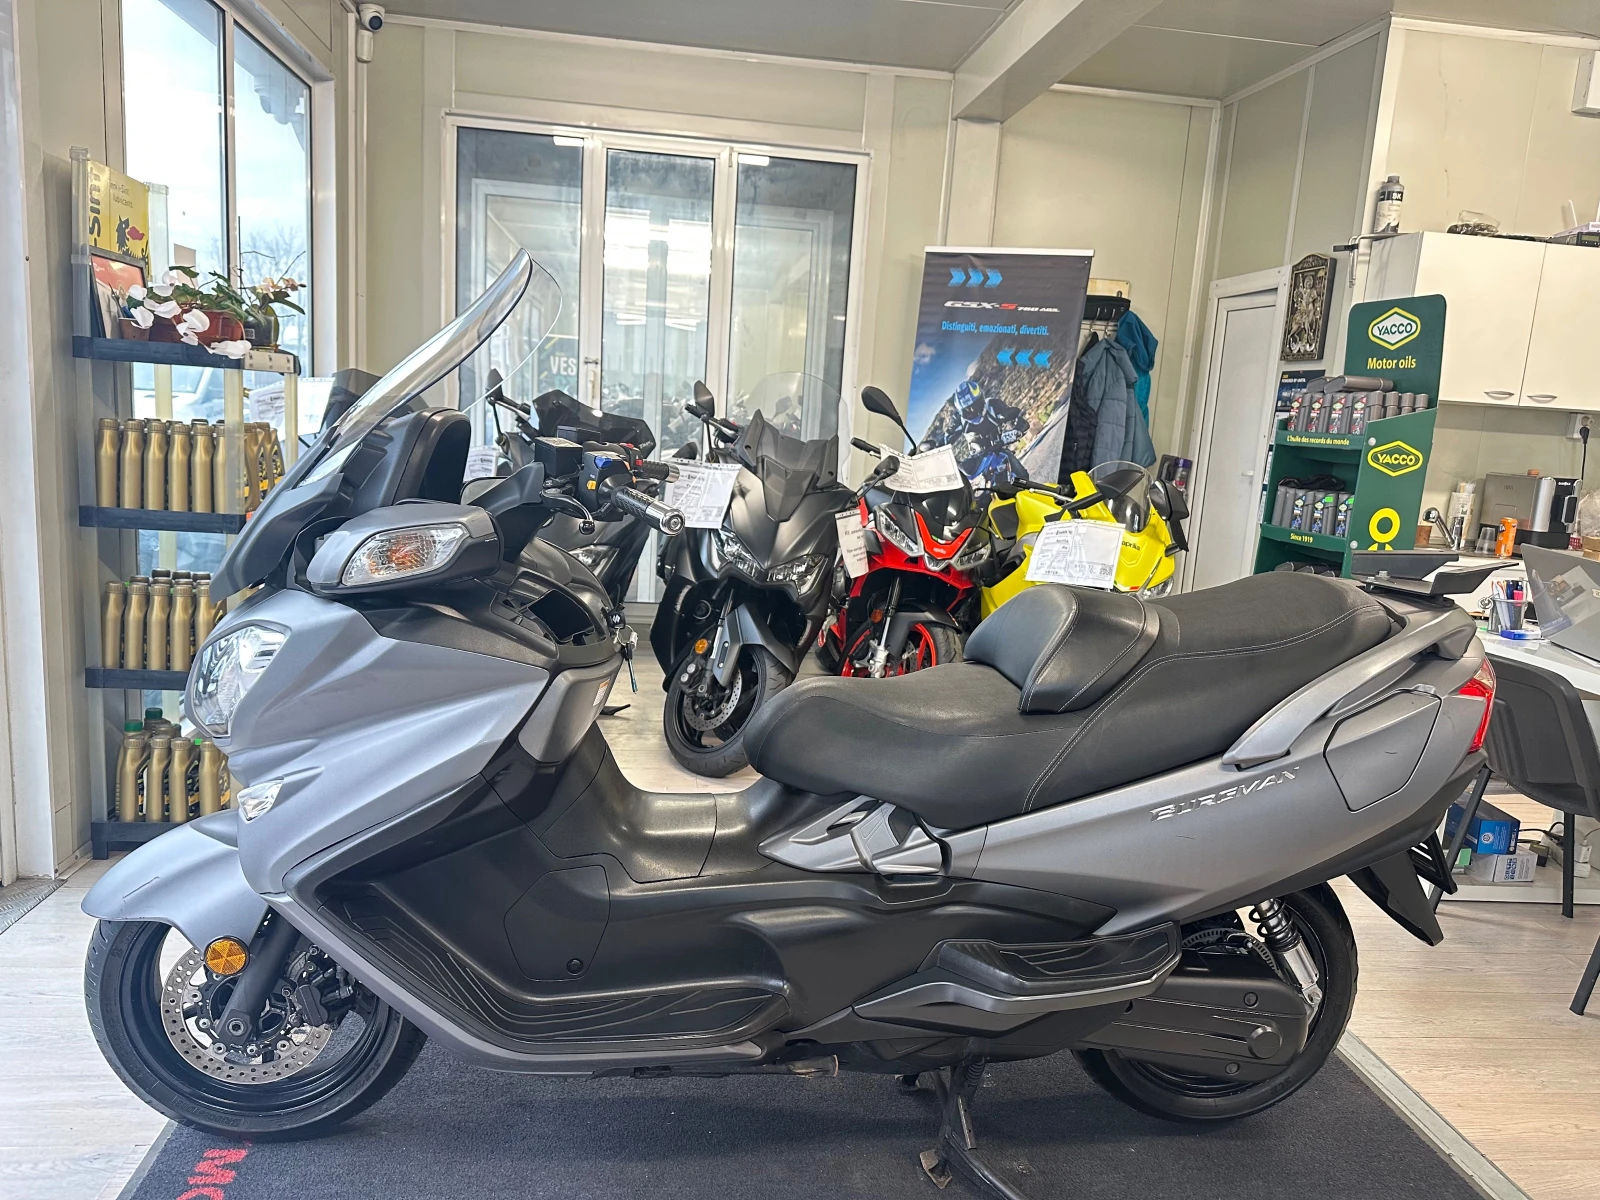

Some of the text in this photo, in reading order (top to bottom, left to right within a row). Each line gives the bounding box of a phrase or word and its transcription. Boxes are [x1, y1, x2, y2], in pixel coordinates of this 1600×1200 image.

[943, 300, 1018, 310] GSX-S
[941, 321, 1049, 336] Distinguiti, emozionati, divertiti.
[1377, 322, 1413, 336] YACCO
[1367, 355, 1417, 370] Motor oils
[1377, 453, 1416, 466] YACCO
[1290, 532, 1313, 543] Since 1919
